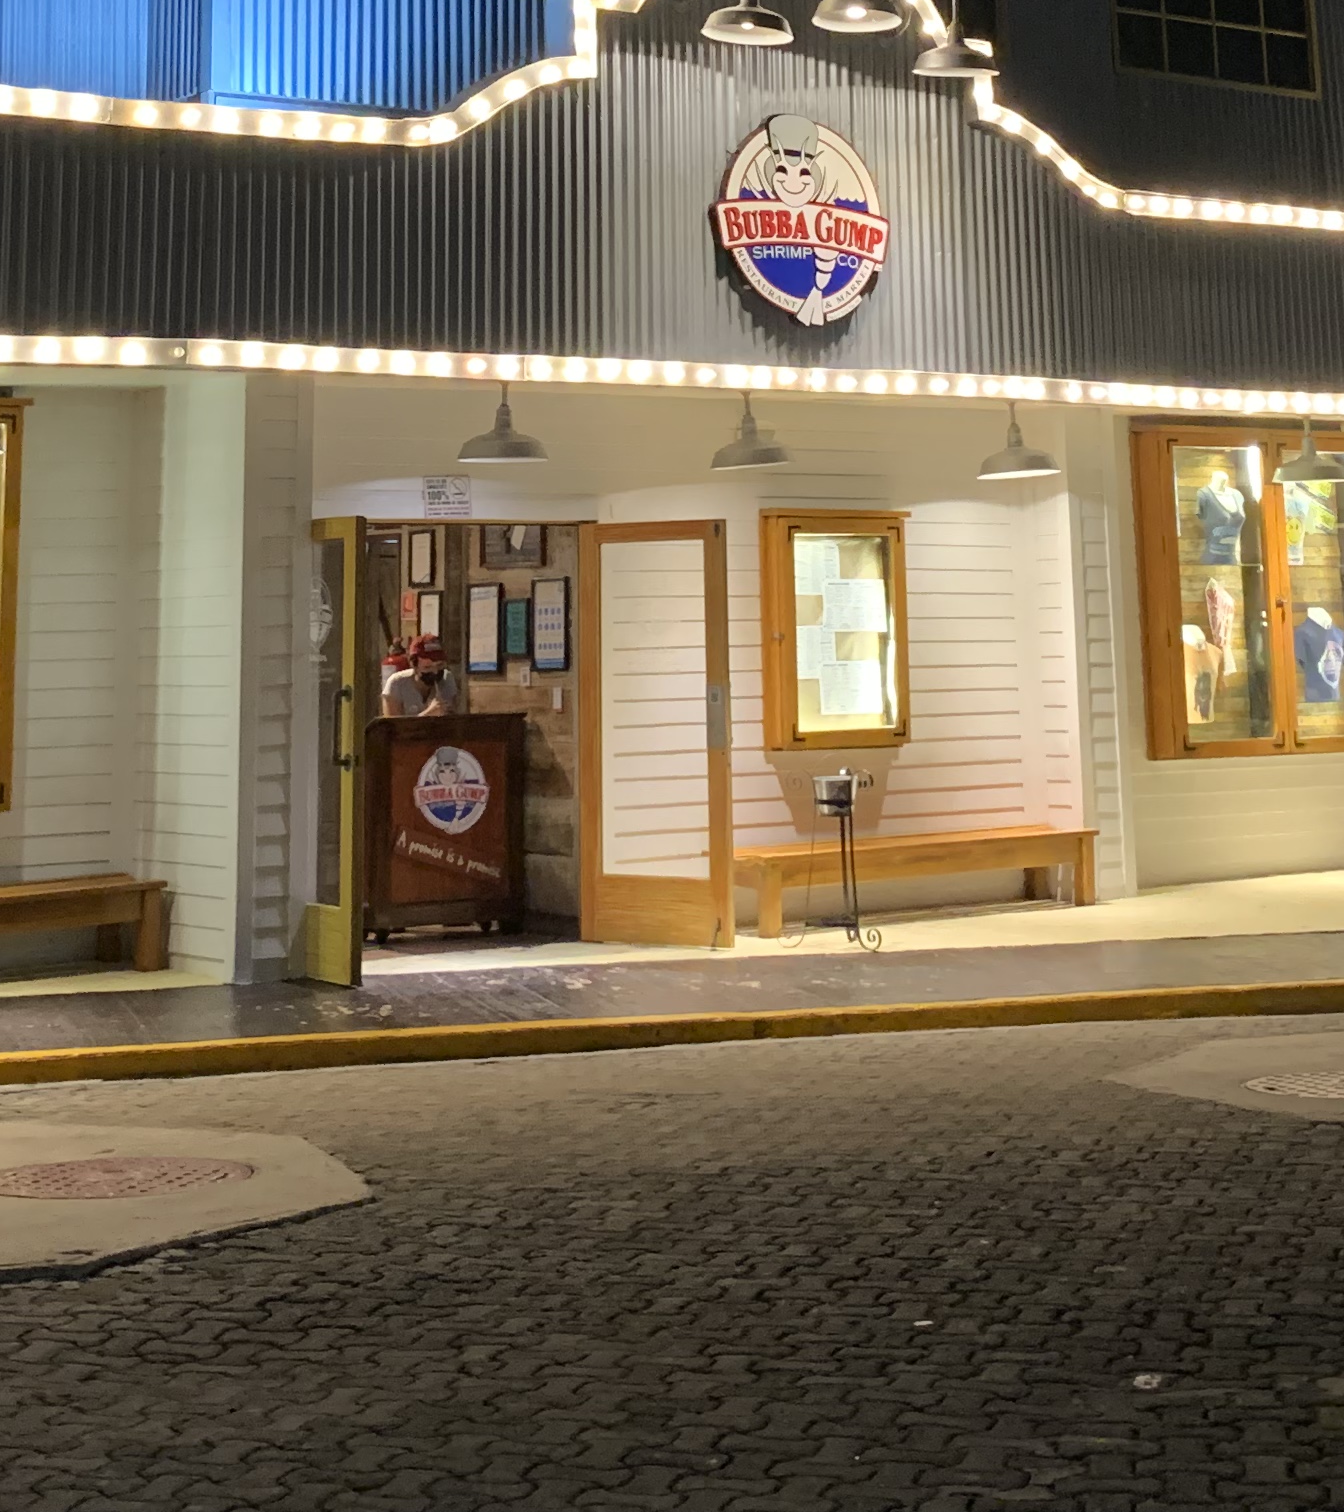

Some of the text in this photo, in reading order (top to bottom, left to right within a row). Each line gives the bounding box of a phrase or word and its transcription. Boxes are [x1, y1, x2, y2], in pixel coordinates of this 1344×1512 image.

[722, 206, 884, 255] BUBBA GUMP
[752, 244, 814, 260] SHRIMP
[737, 249, 798, 309] RESTAURANT
[836, 264, 870, 305] MARKET
[396, 829, 407, 848] A
[408, 841, 444, 860] promise
[466, 859, 501, 878] promise
